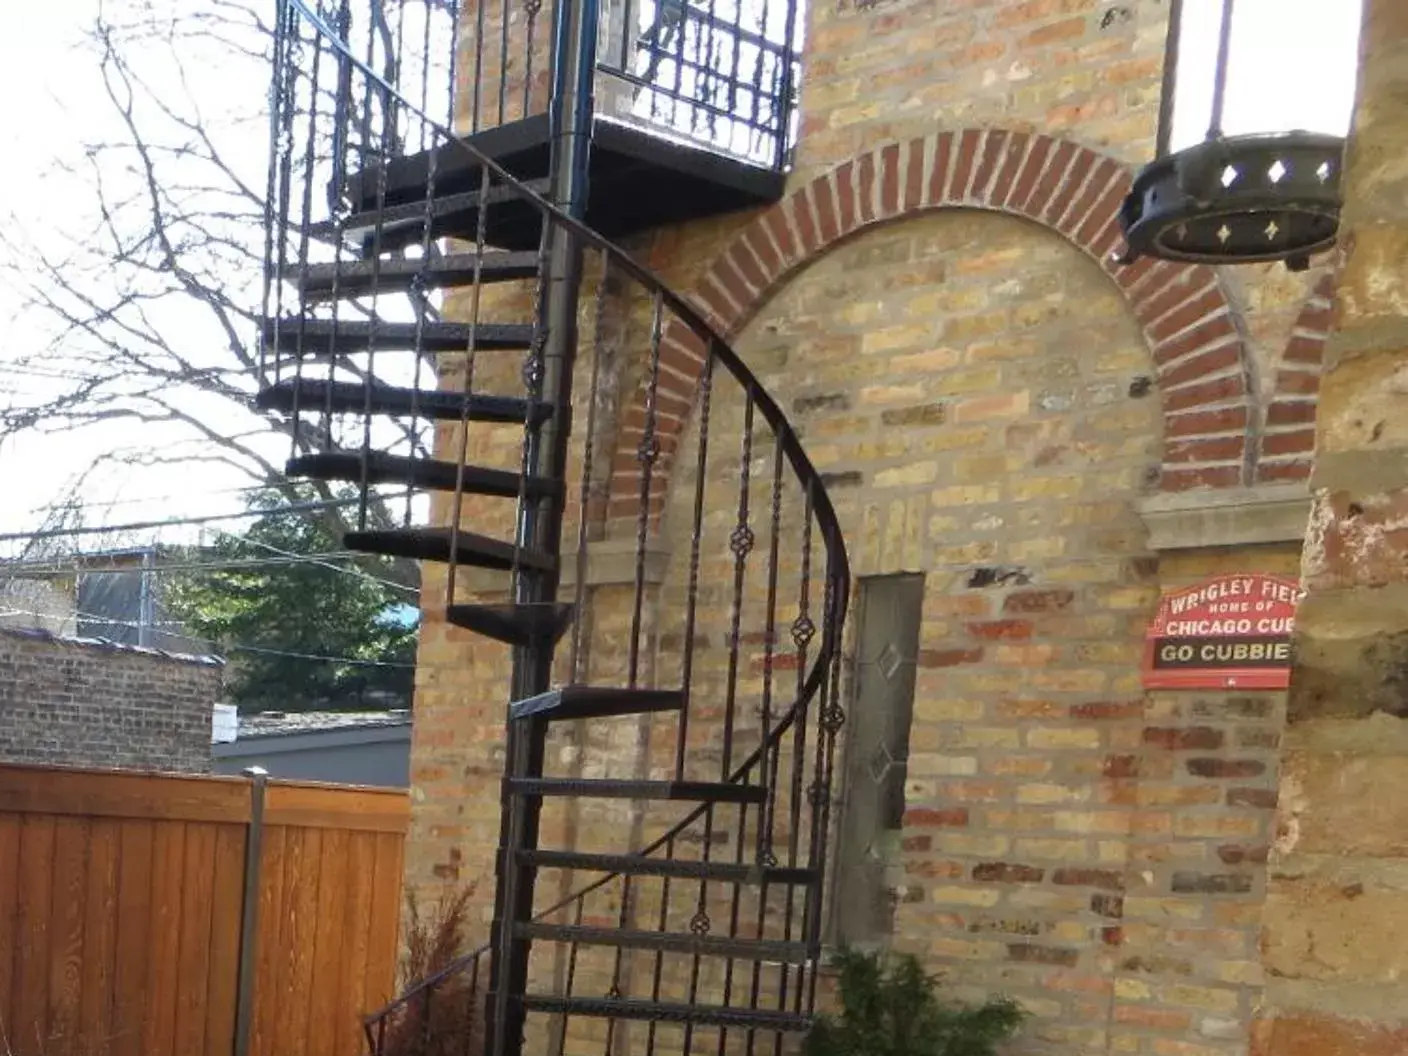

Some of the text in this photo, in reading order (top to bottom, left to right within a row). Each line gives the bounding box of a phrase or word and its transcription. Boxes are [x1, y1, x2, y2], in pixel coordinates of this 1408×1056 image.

[1170, 579, 1254, 615] WRIGLEY
[1209, 601, 1273, 613] HOME OF
[1166, 619, 1250, 636] CHICAGO
[1161, 644, 1194, 662] GO
